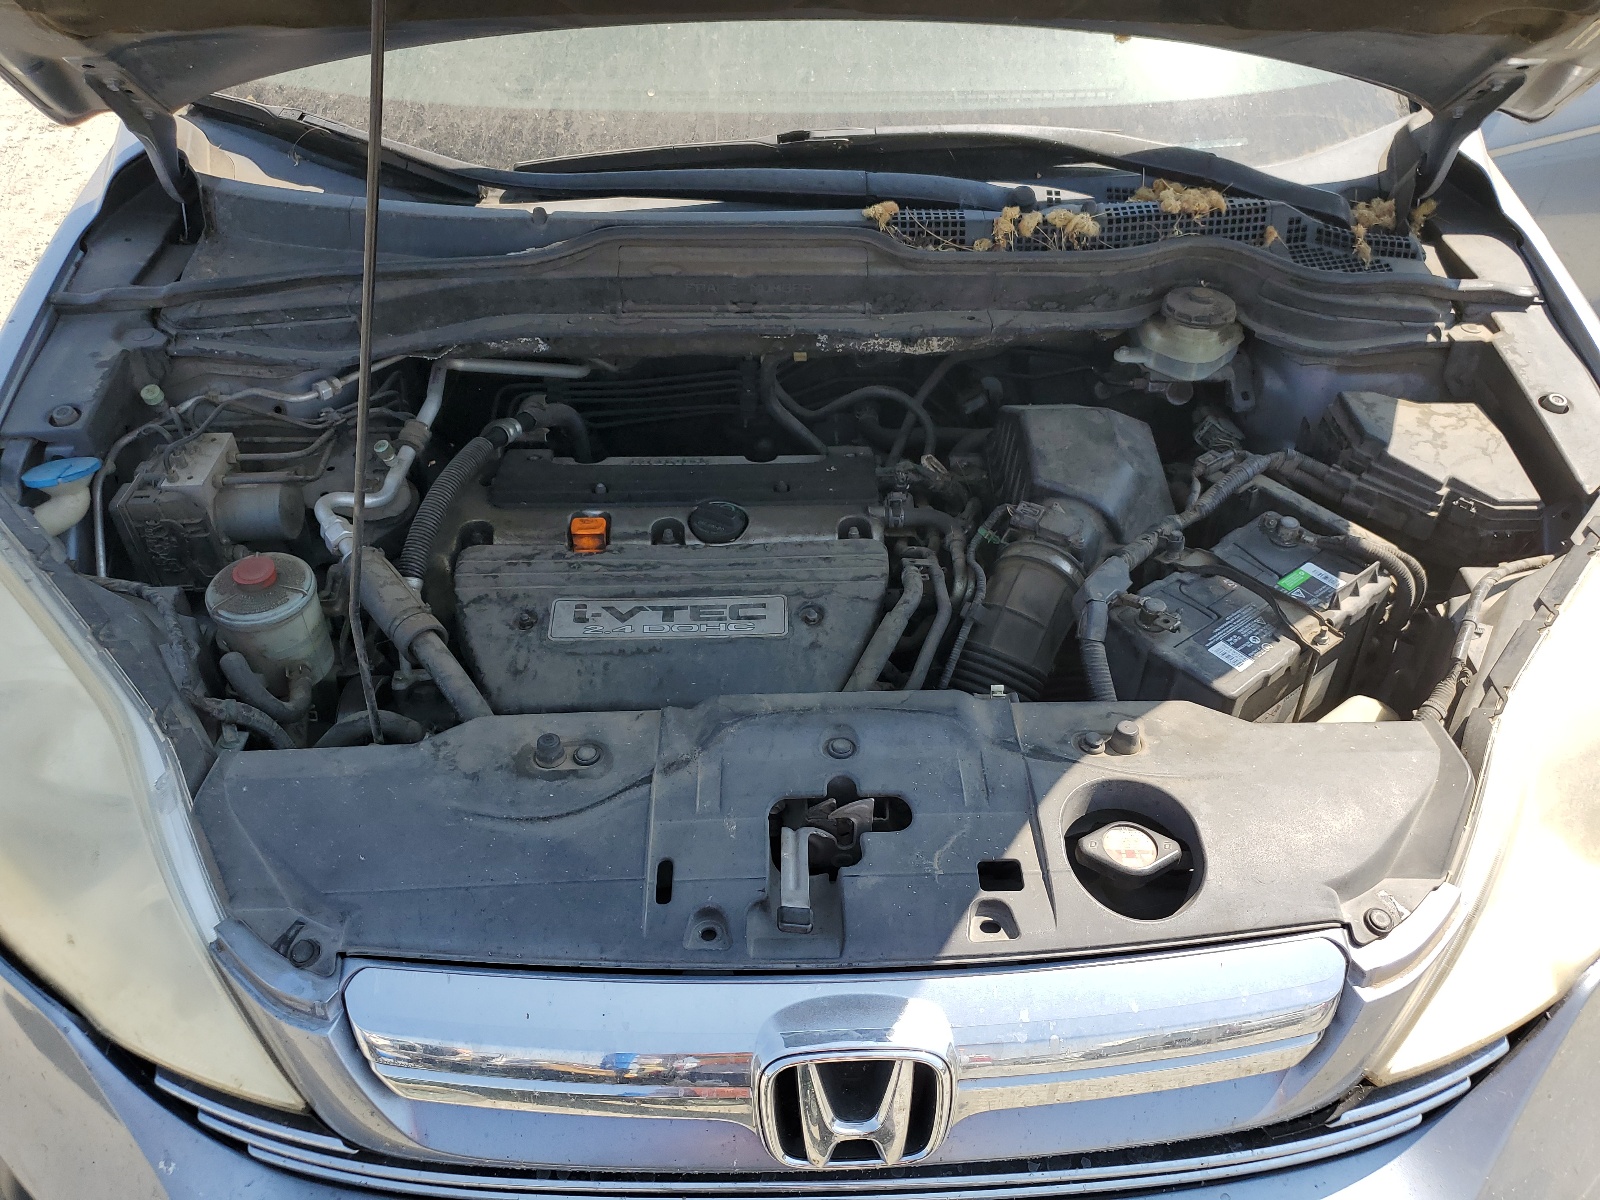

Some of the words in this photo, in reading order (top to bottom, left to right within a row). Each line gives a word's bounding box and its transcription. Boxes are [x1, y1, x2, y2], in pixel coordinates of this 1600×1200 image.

[573, 602, 767, 623] i-VTEC
[582, 624, 635, 635] 2.4
[642, 622, 756, 634] DOHC
